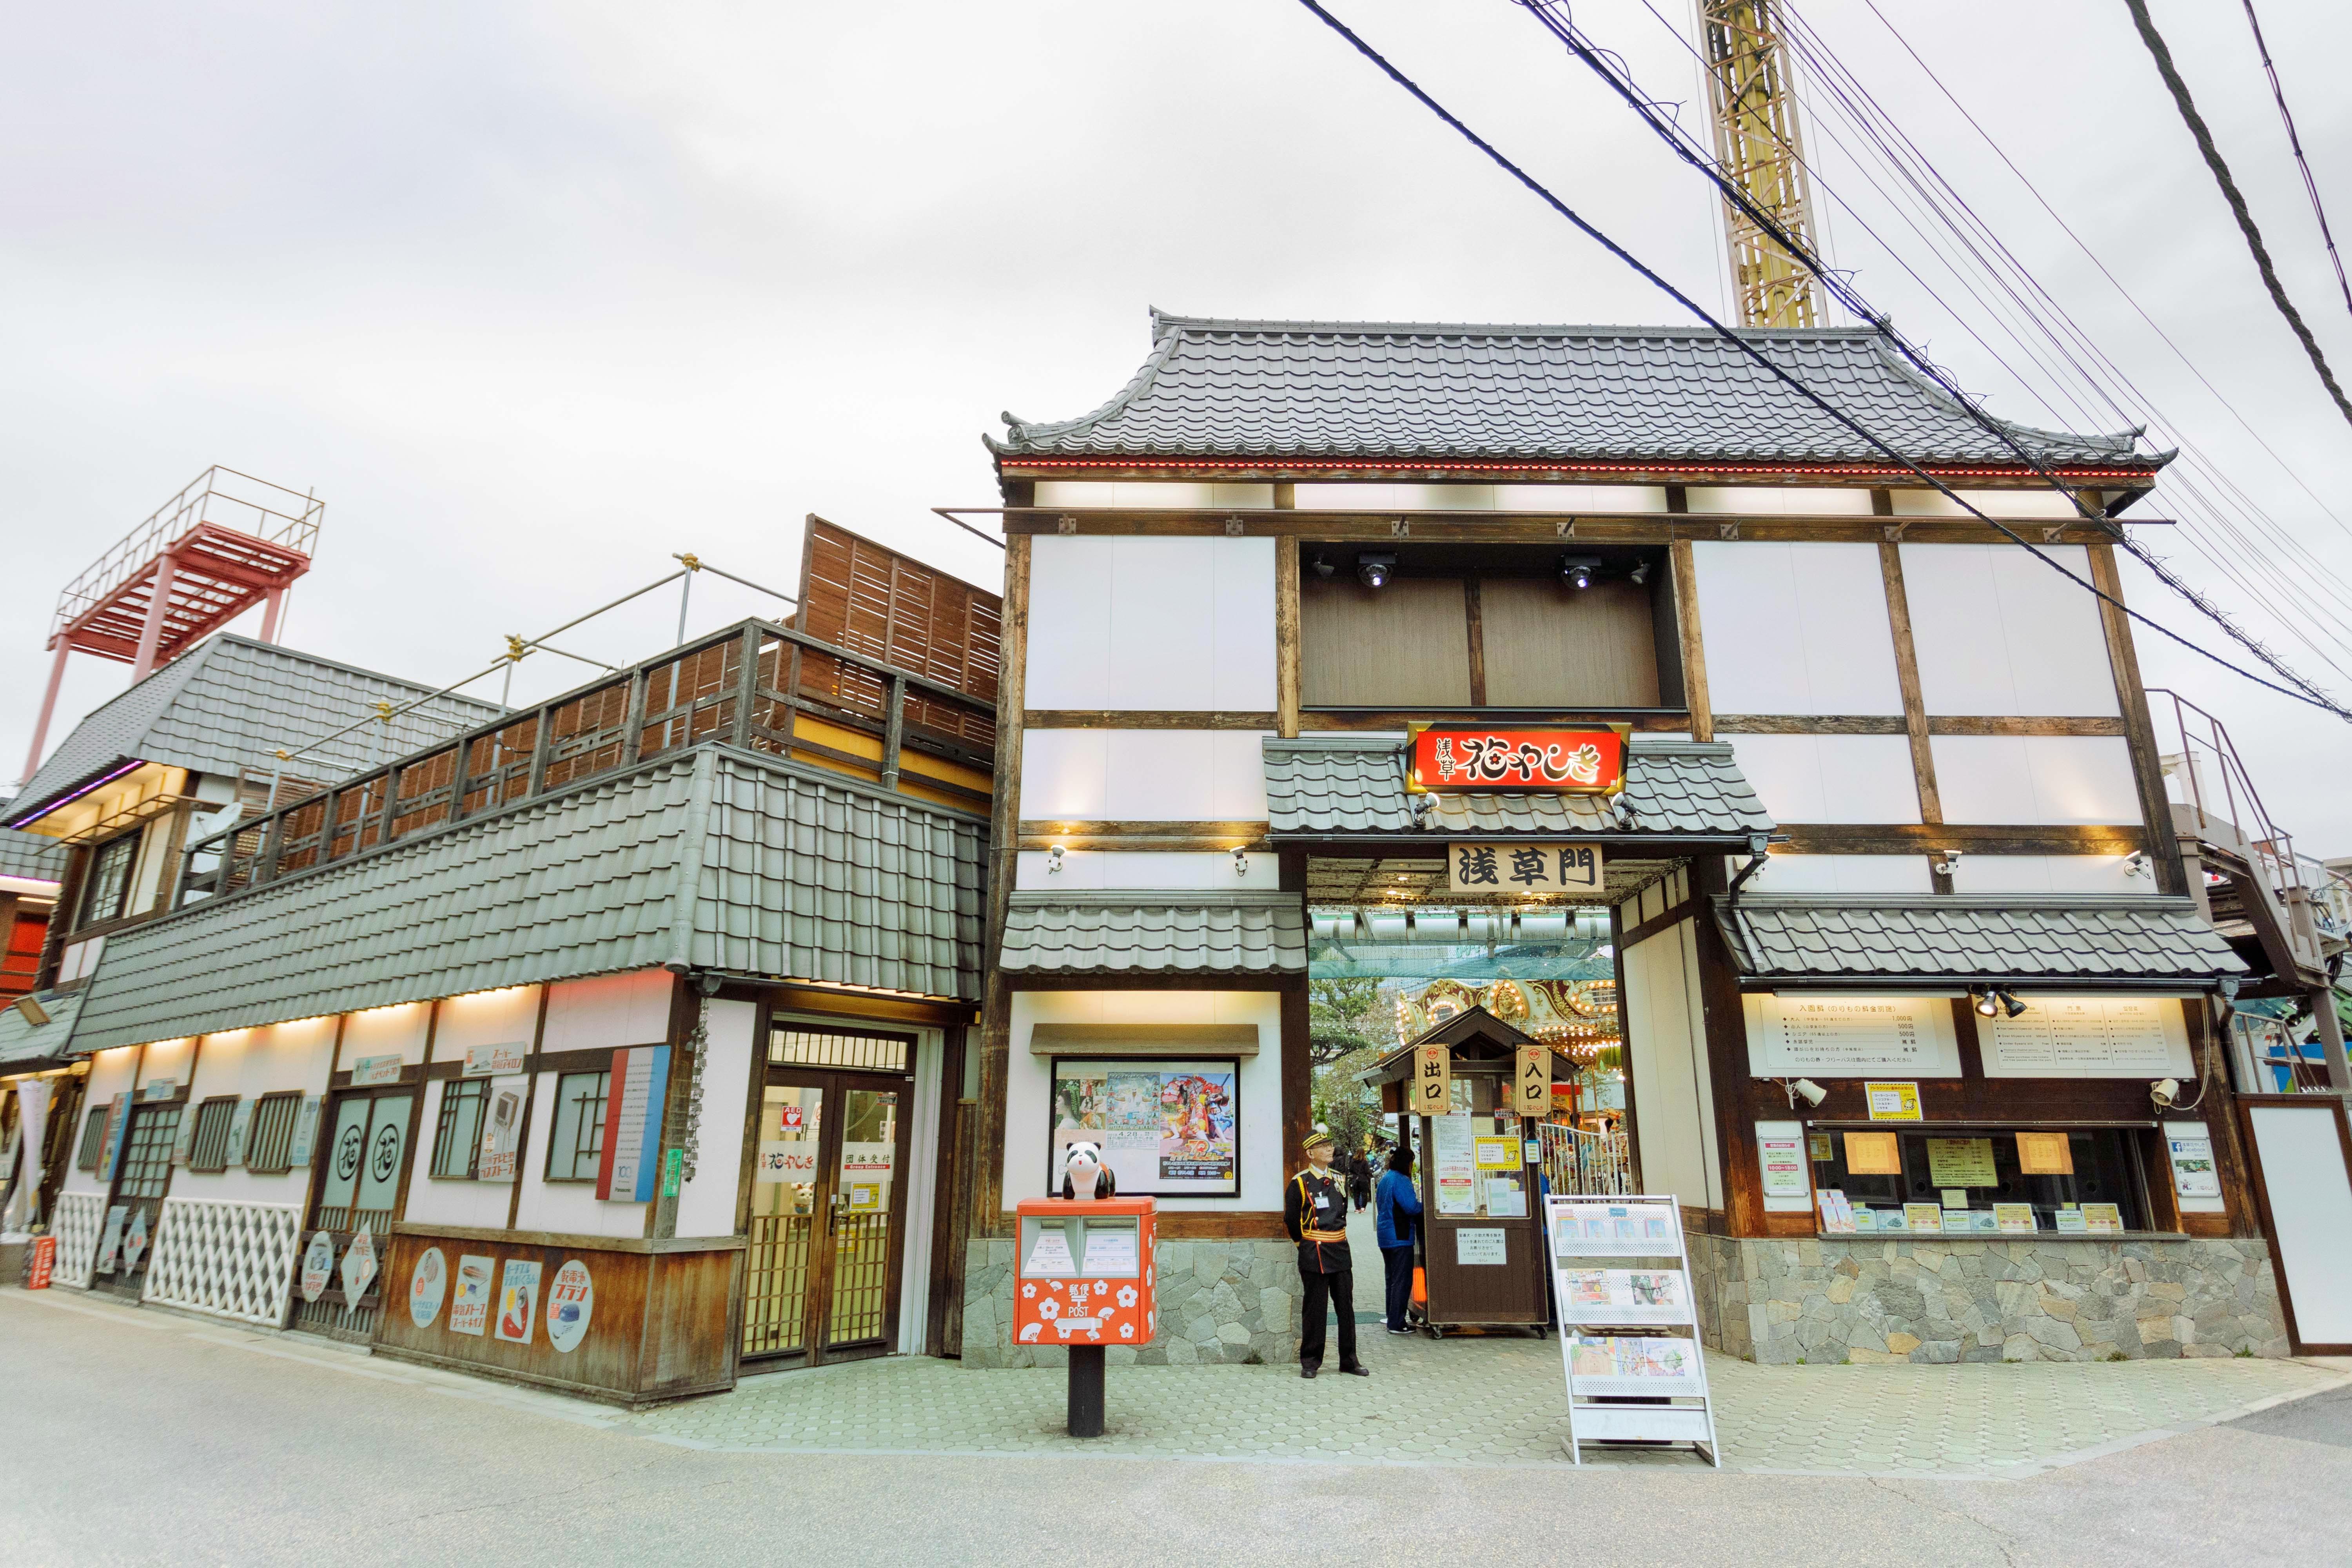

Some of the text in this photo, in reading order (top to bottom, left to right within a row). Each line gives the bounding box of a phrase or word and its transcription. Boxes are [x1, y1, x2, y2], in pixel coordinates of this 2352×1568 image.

[1436, 738, 1454, 780] 浅草
[1456, 736, 1600, 781] 花やしき
[1459, 847, 1595, 886] 浅草門
[492, 1049, 512, 1059] スーパー
[1424, 1061, 1441, 1099] 出口
[1525, 1062, 1543, 1099] 入口
[768, 1152, 813, 1169] 花やしき
[846, 1154, 890, 1163] 団体受付
[561, 1269, 586, 1285] 乾電池
[1069, 1284, 1089, 1296] 郵便
[452, 1303, 486, 1316] 電気ストーブ
[1068, 1307, 1089, 1317] POST
